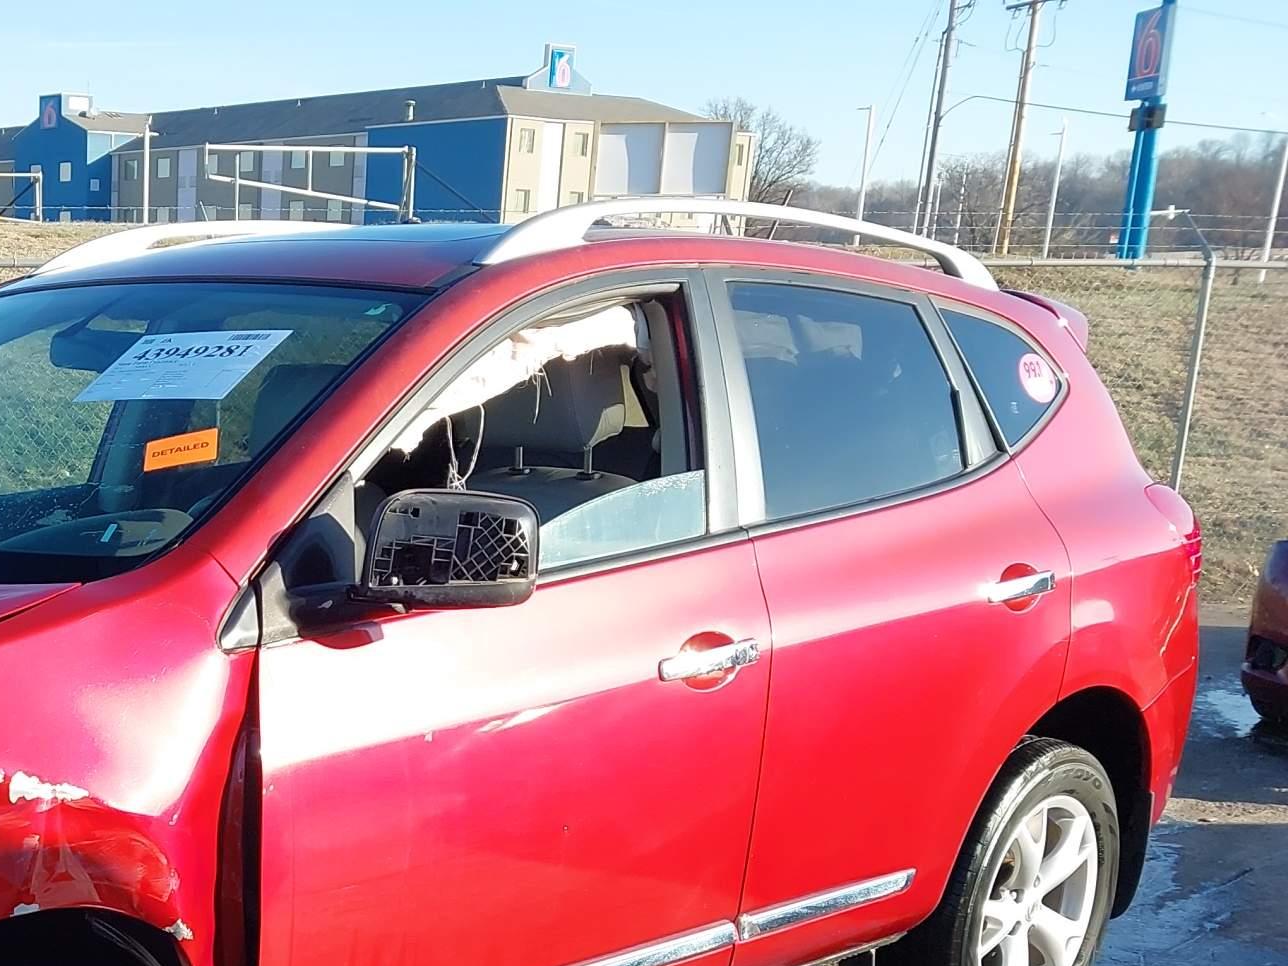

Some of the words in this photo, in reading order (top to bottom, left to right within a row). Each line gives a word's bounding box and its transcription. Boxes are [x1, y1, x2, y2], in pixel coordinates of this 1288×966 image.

[1135, 9, 1161, 77] 6
[558, 54, 571, 87] 6
[43, 100, 57, 128] 6
[133, 344, 254, 361] 43949281
[151, 441, 210, 458] DETAILED
